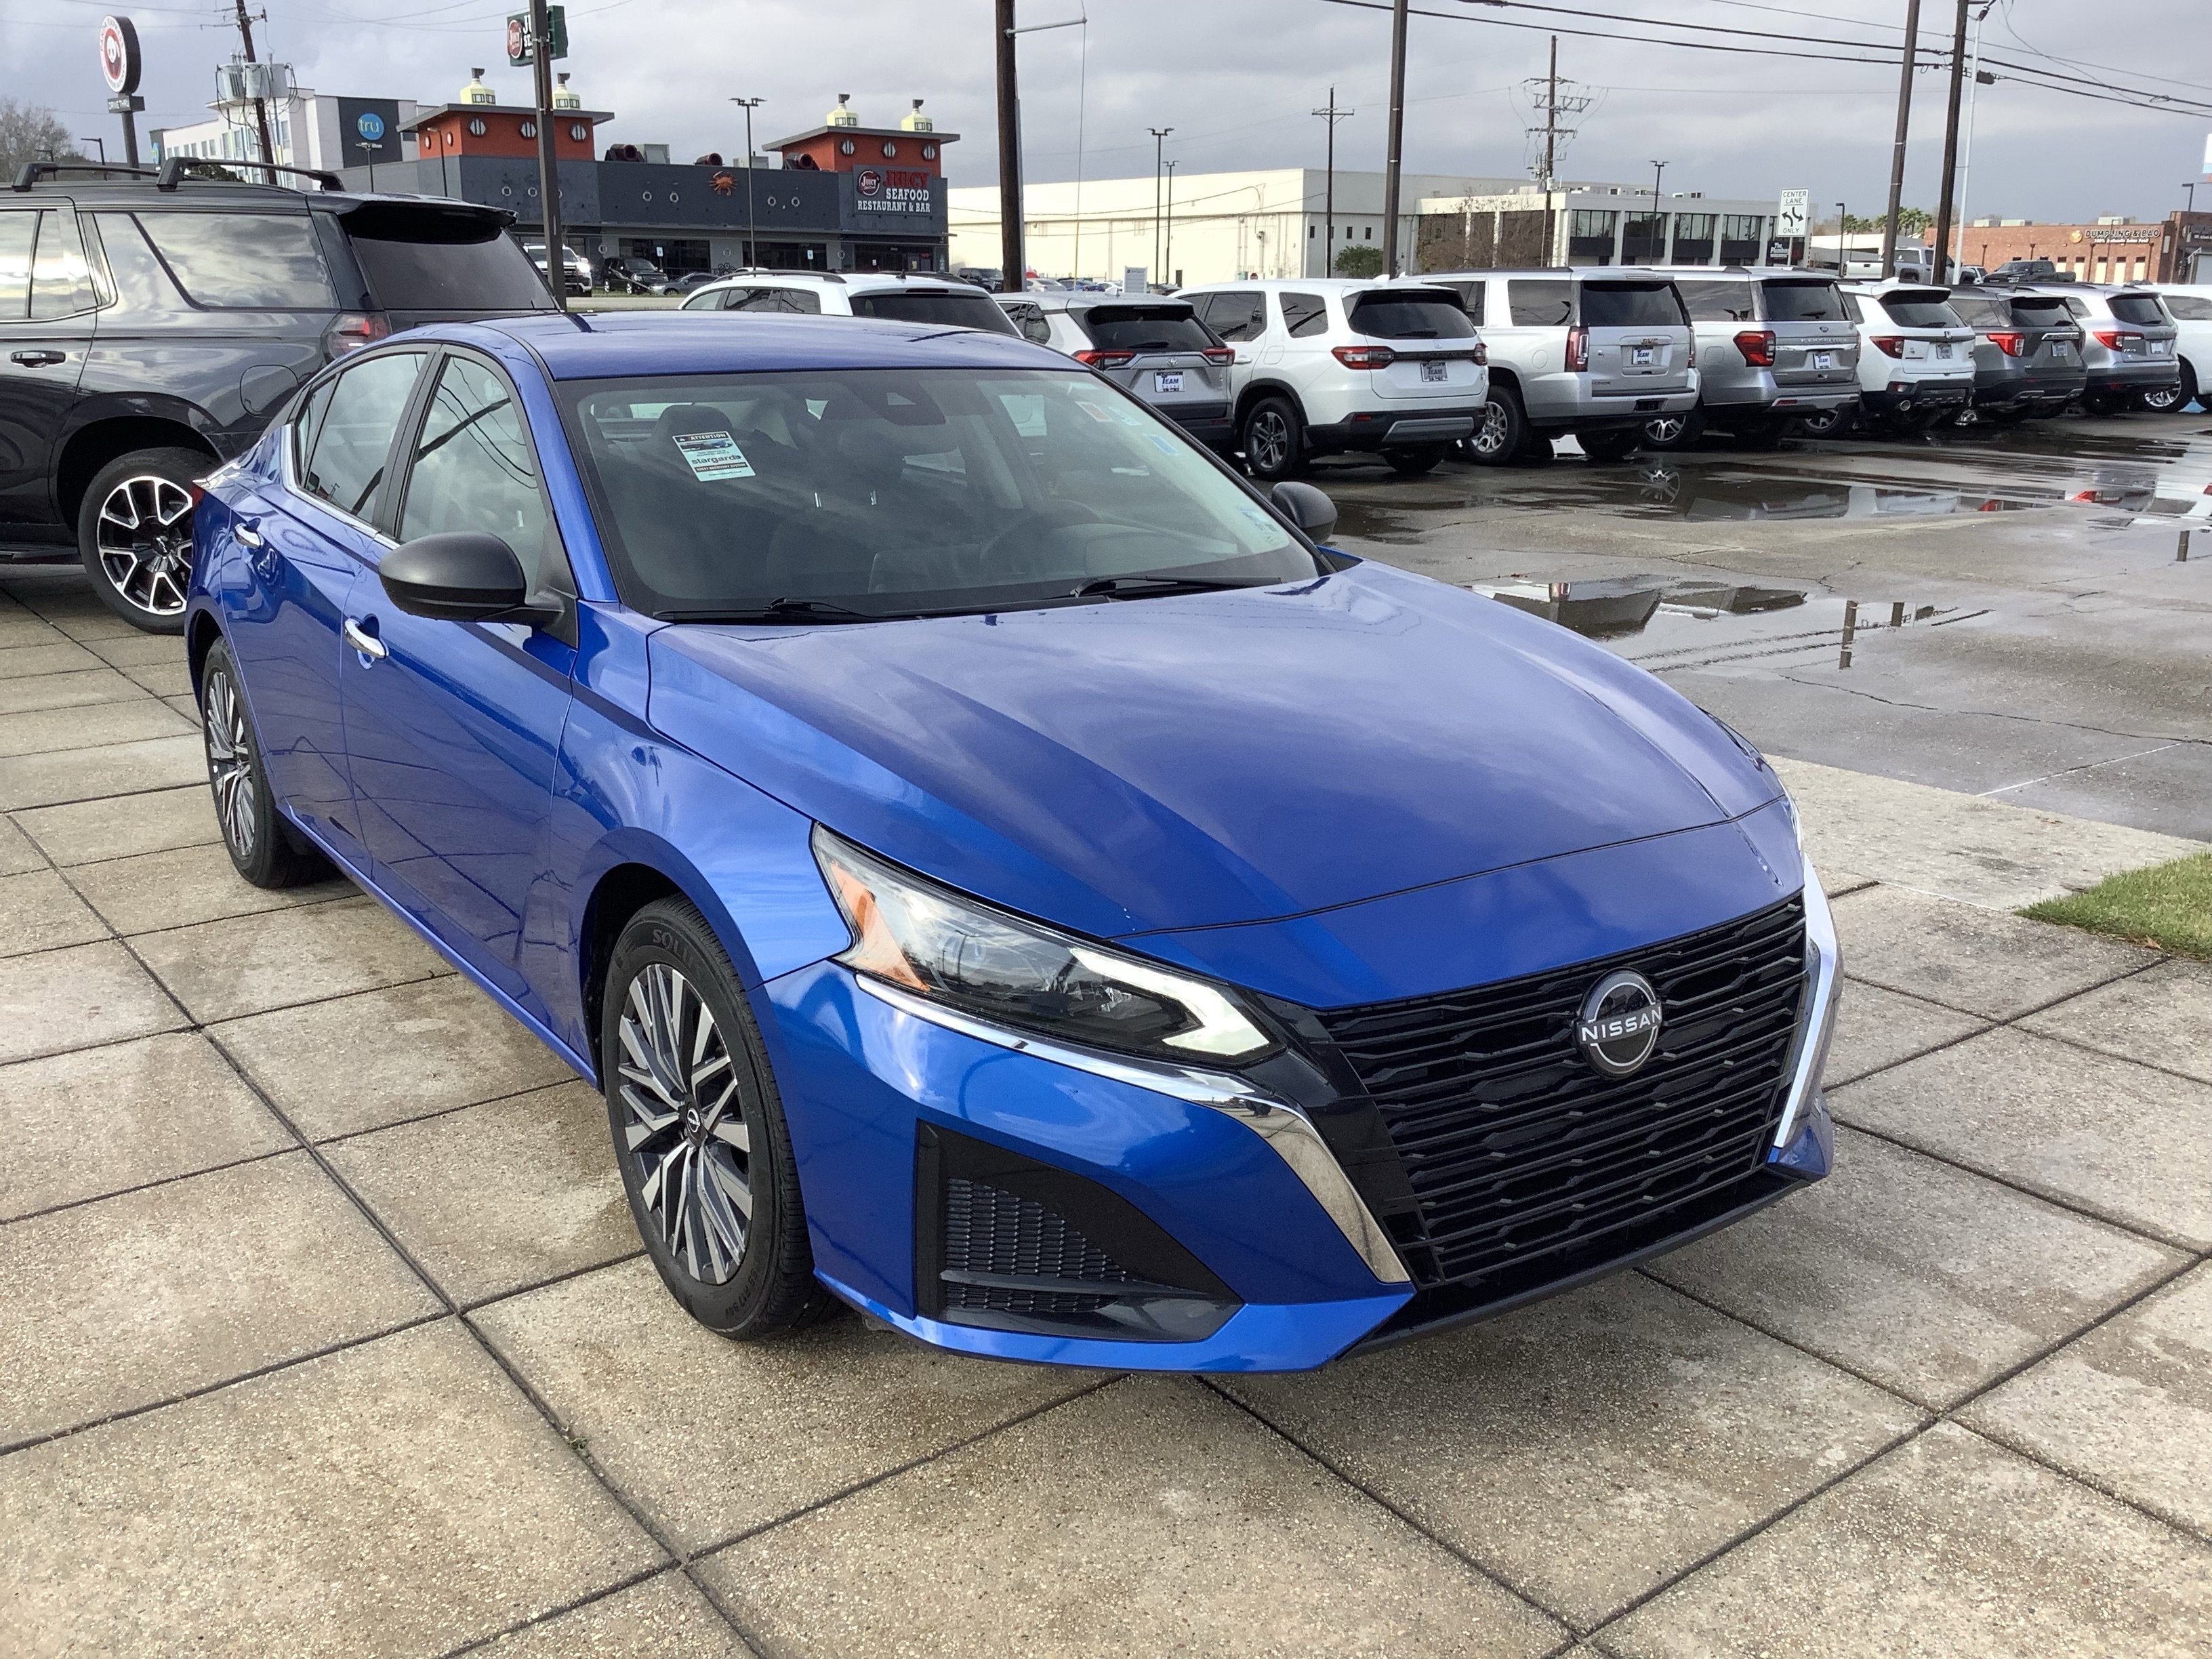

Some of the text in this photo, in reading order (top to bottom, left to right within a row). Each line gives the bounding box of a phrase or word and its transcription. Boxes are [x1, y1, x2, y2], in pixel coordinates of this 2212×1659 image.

[359, 119, 380, 133] tru
[861, 176, 877, 186] JUICY
[883, 170, 929, 188] JUICY
[886, 188, 930, 201] SEAFOOD
[857, 200, 931, 213] RESTAURANT & BAR
[2085, 229, 2131, 239] DUMPLING
[2141, 229, 2161, 239] BAO
[1161, 374, 1179, 384] TEAM
[1581, 1006, 1661, 1042] NISSAN
